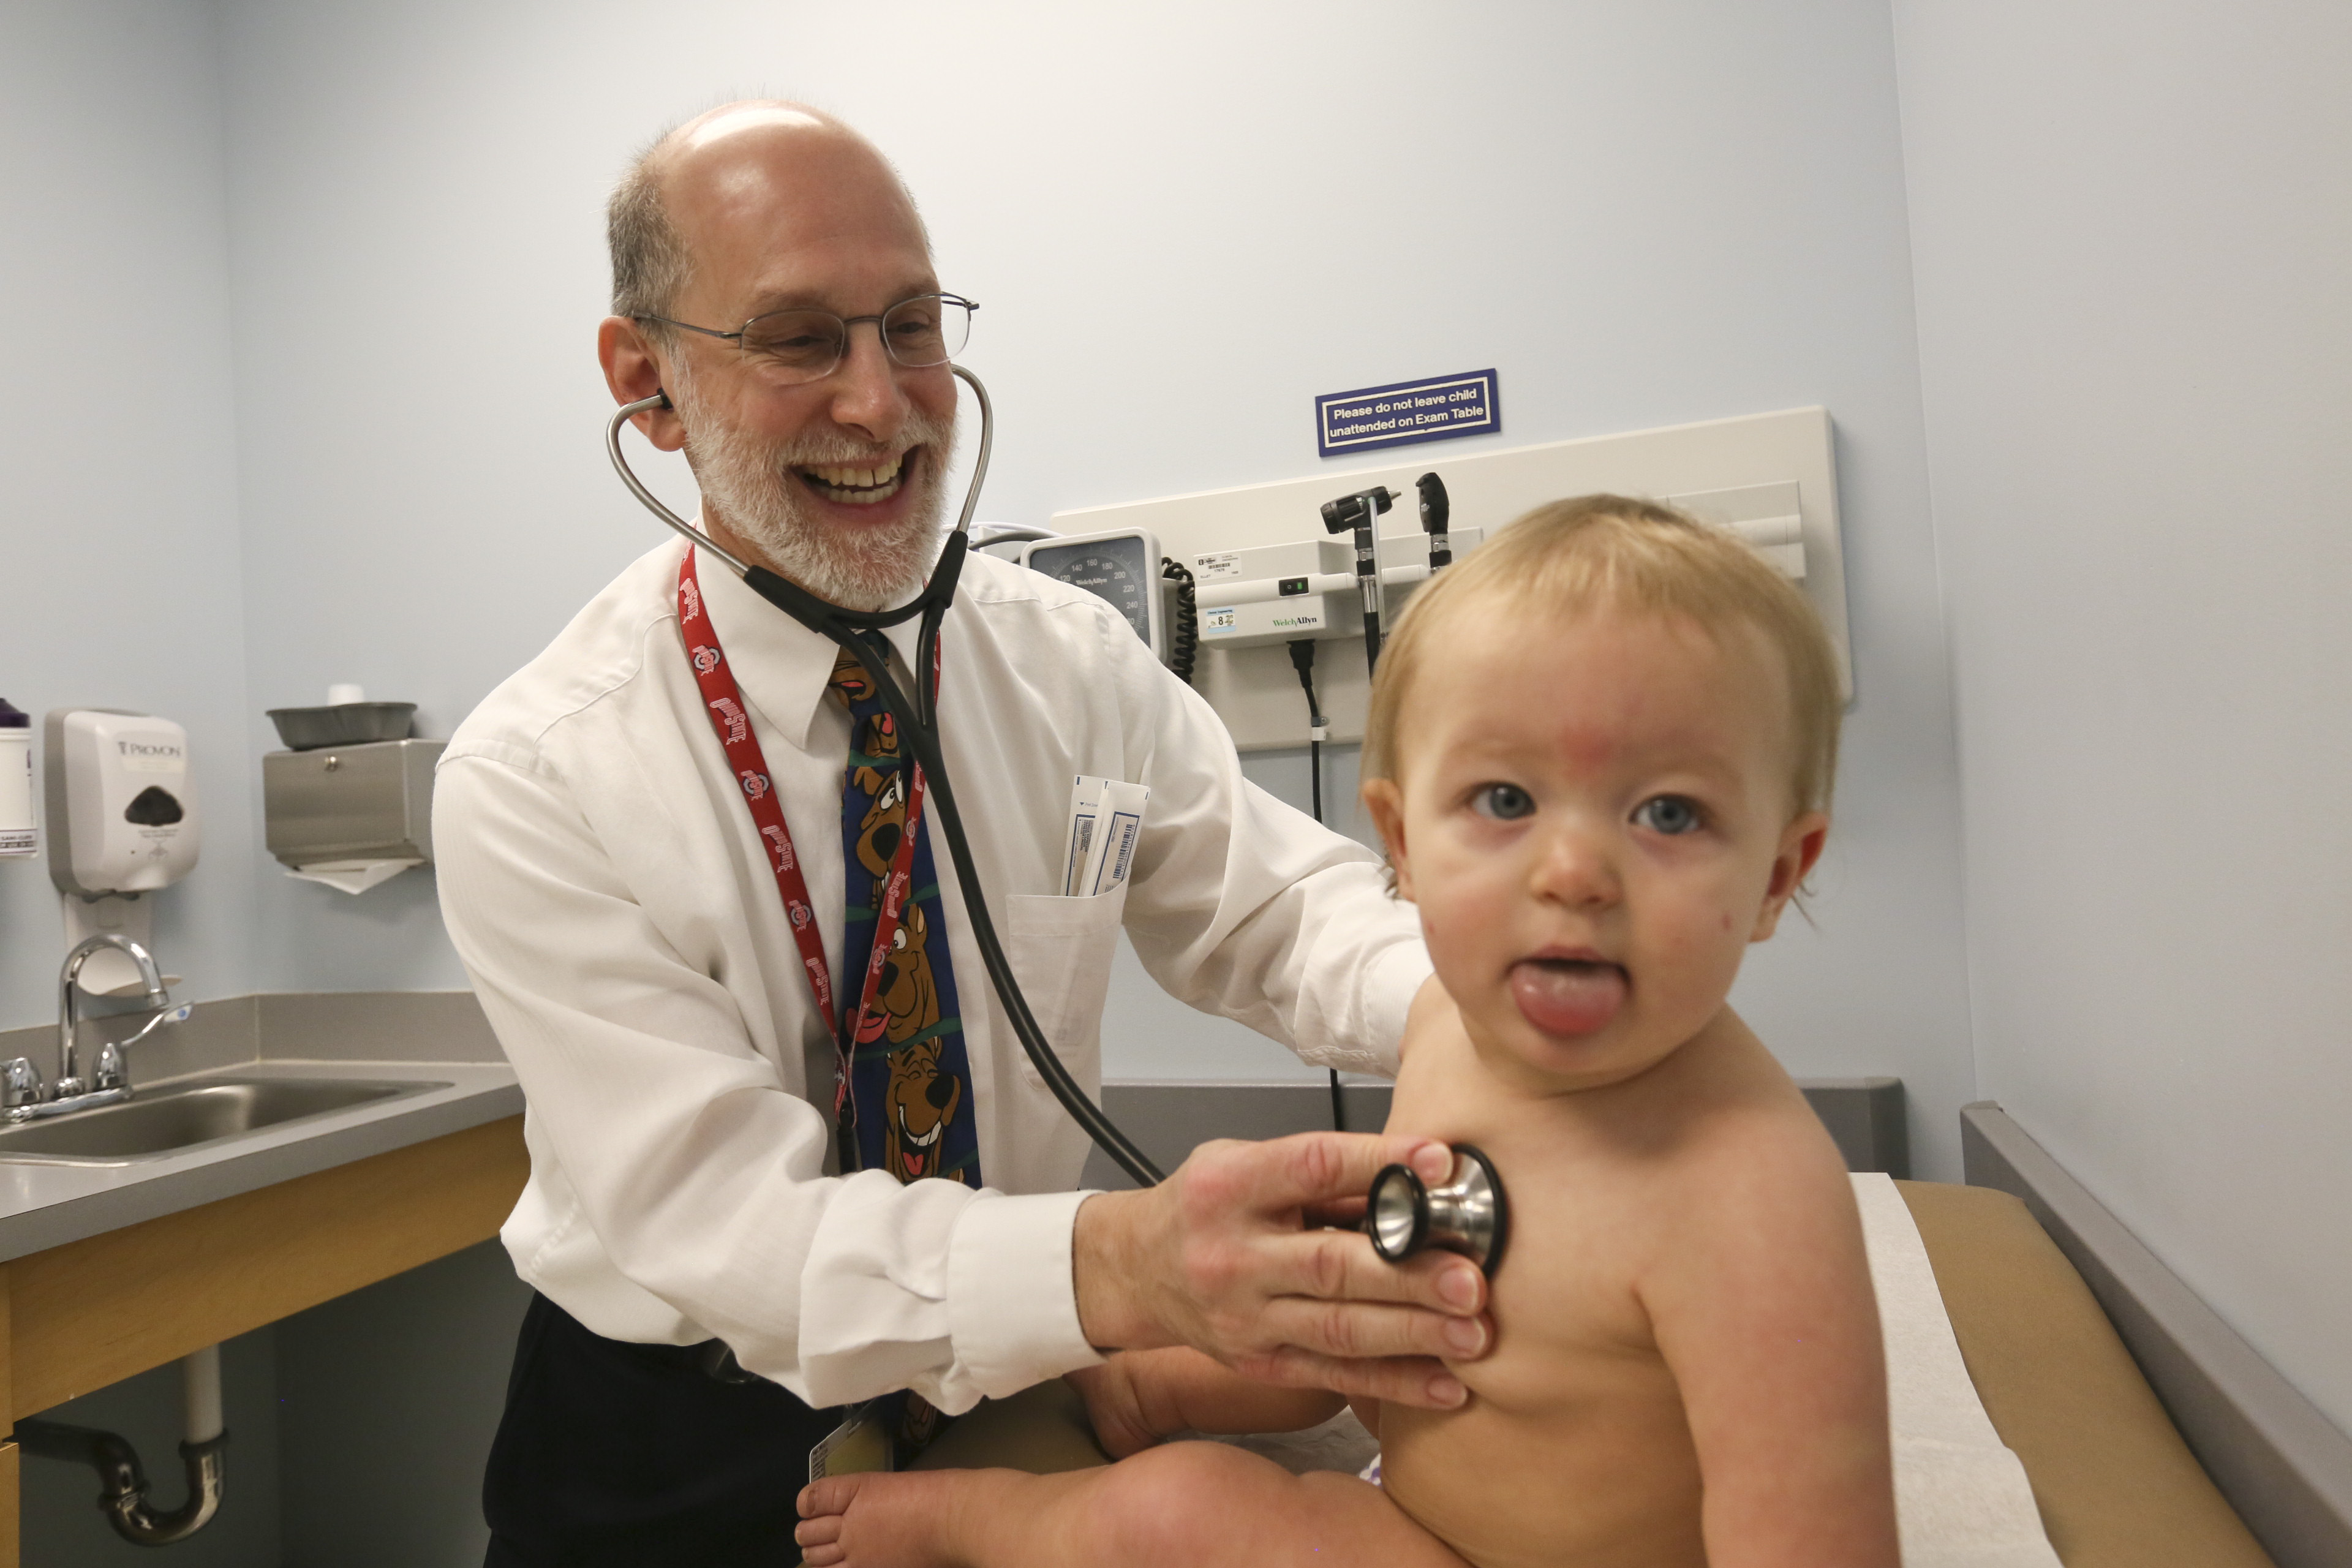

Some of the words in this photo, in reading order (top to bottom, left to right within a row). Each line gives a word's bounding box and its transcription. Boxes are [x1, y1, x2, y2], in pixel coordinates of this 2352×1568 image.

[1333, 407, 1373, 420] Please
[1375, 402, 1391, 414] do
[1393, 399, 1412, 411] not
[1415, 394, 1446, 407] leave
[1448, 388, 1477, 402] child
[1330, 418, 1396, 437] unattended
[1398, 417, 1414, 428] on
[1415, 412, 1449, 424] Exam
[1450, 405, 1484, 419] Table
[1114, 571, 1126, 579] 200
[1123, 584, 1134, 593] 220
[1126, 601, 1138, 609] 240
[1218, 616, 1223, 625] 8
